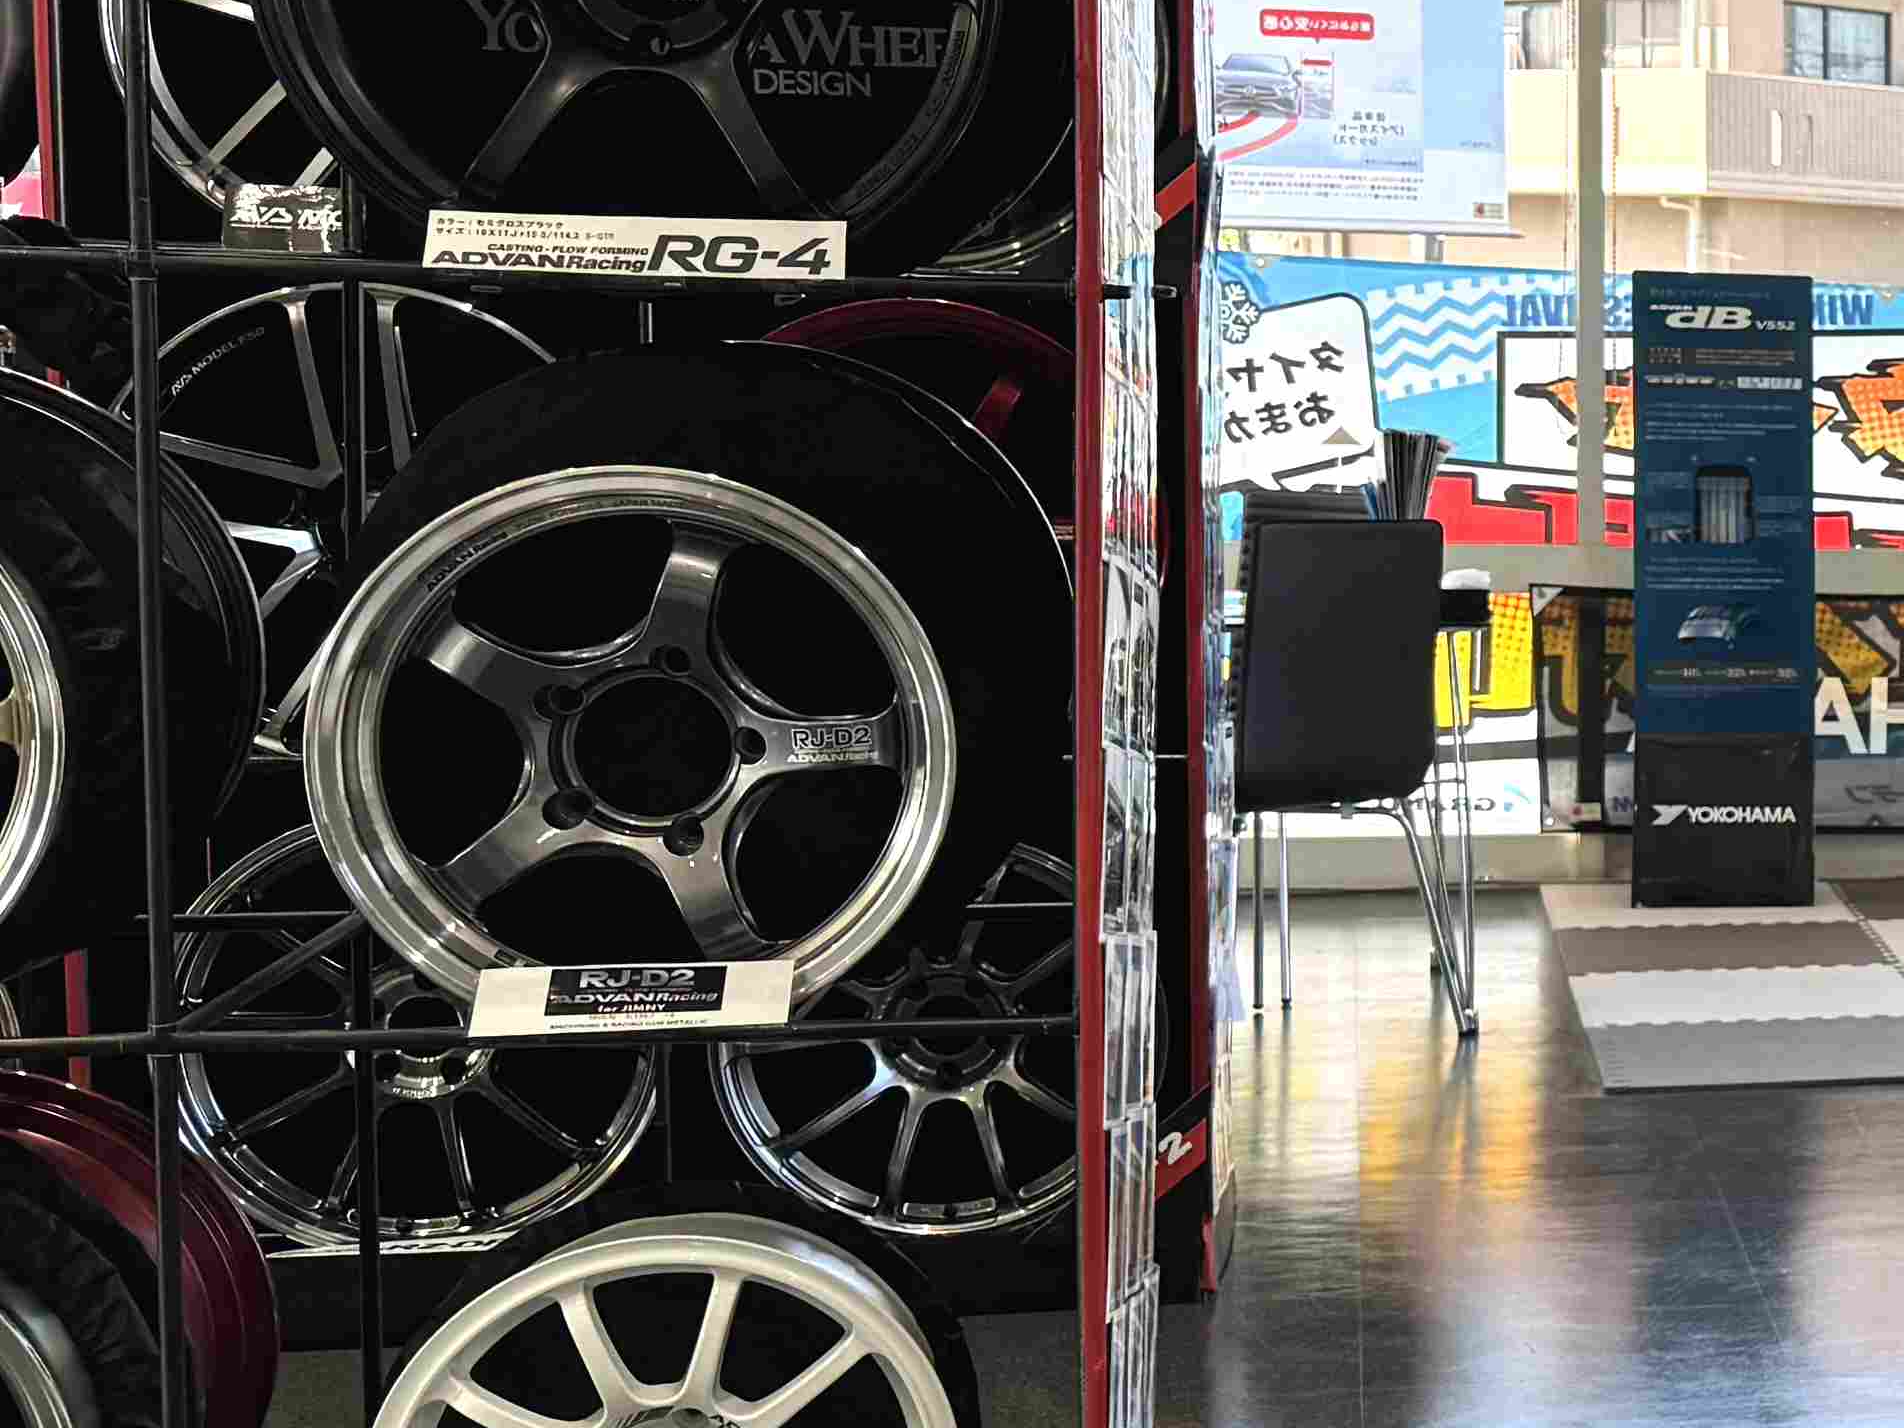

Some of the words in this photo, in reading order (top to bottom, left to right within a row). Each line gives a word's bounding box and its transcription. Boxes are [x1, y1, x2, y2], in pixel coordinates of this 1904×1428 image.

[753, 69, 873, 97] DESIGN
[647, 233, 831, 276] RG-4
[1665, 305, 1753, 330] dB
[1755, 320, 1796, 331] V552
[791, 724, 873, 750] RJ-D2
[1687, 804, 1797, 824] YOKOHAMA
[578, 968, 696, 989] RJ-D2
